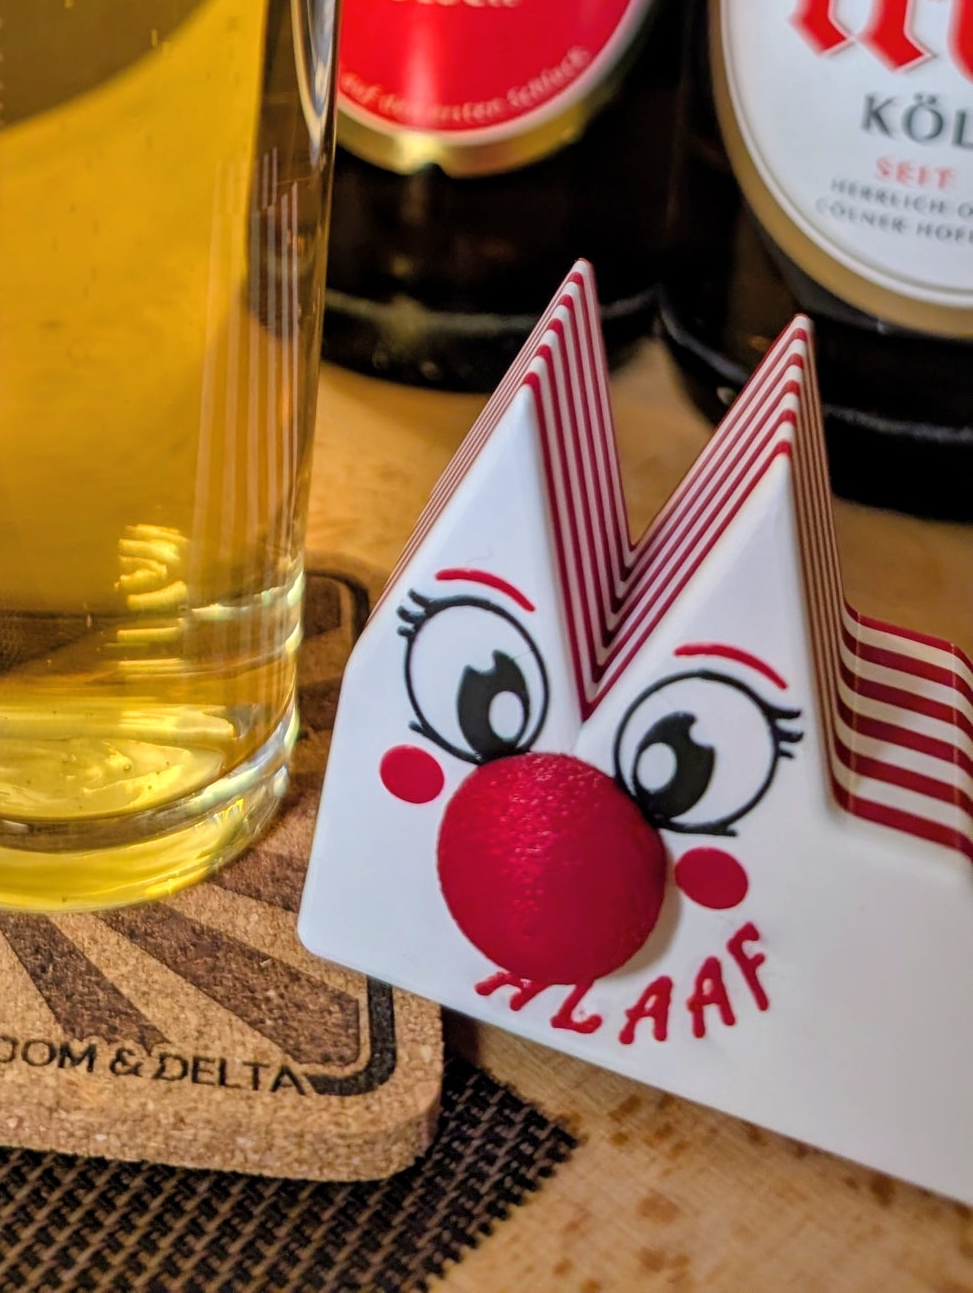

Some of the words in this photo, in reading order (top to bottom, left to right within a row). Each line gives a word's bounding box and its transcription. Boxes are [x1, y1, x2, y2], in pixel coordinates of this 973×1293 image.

[860, 90, 973, 150] KÖL
[875, 156, 954, 190] SEIT
[474, 921, 770, 1045] ALAAF
[108, 1047, 143, 1078] &
[151, 1051, 308, 1096] DELTA
